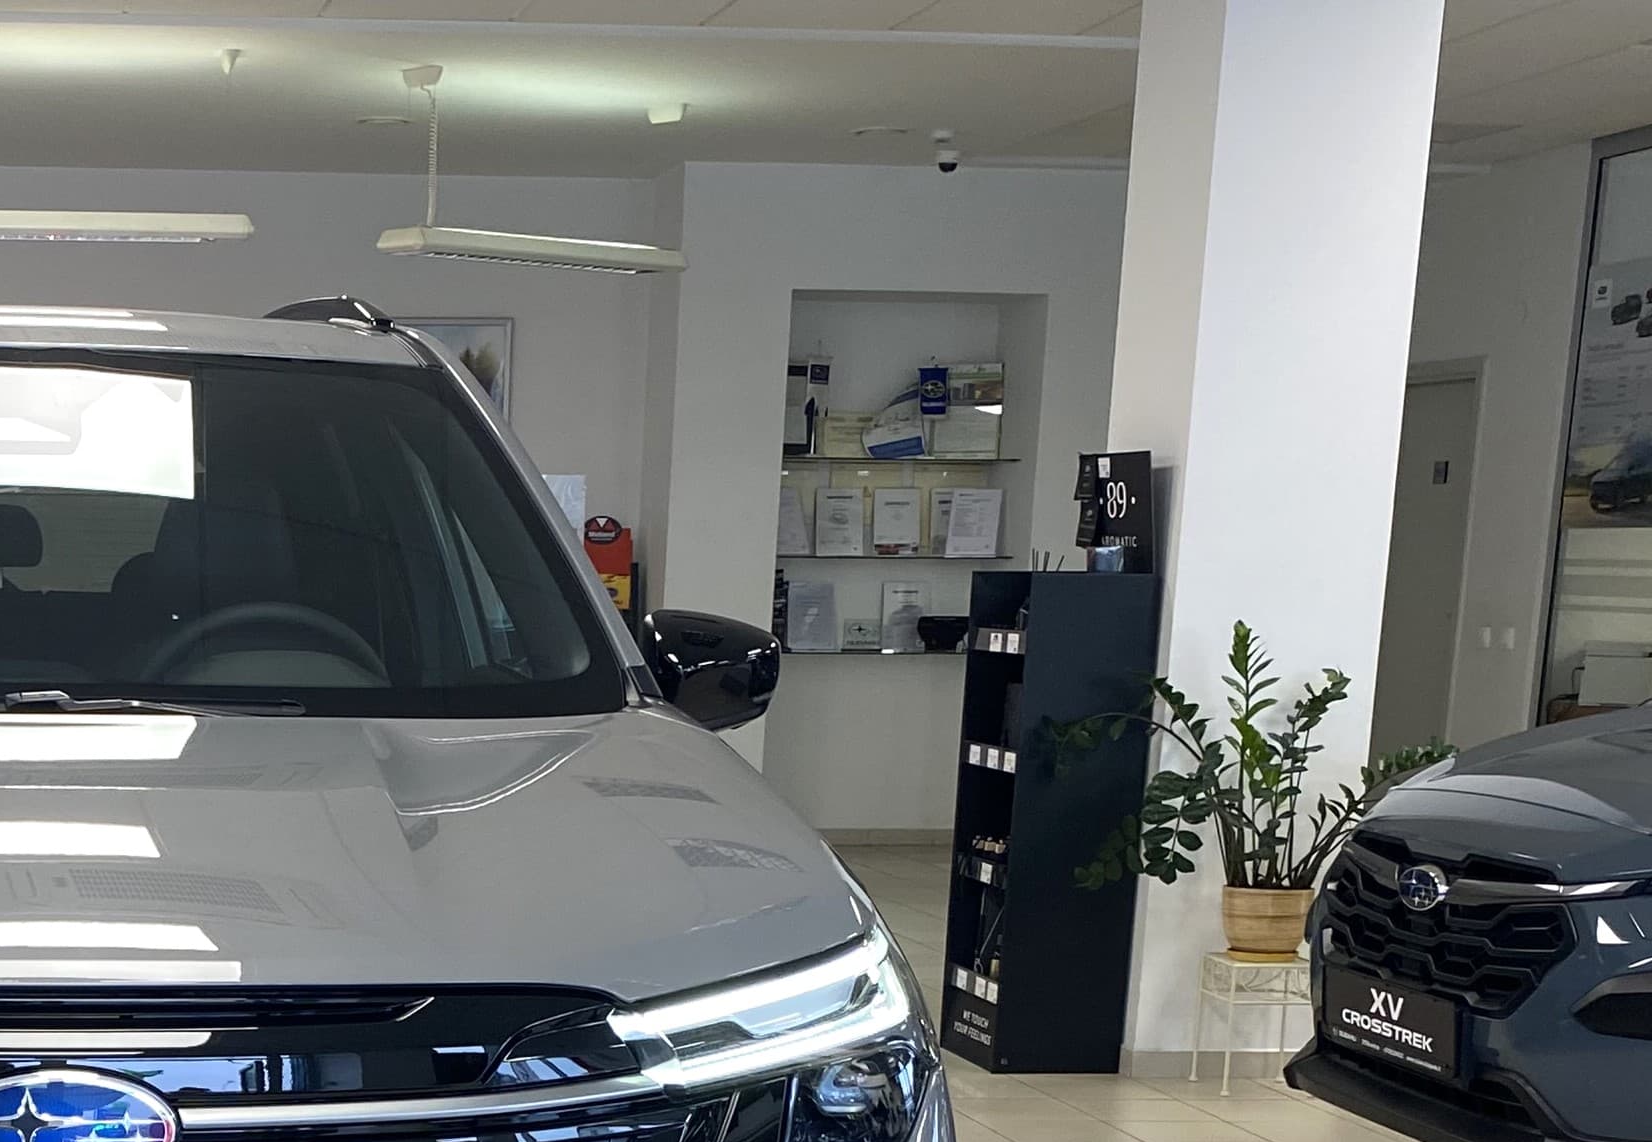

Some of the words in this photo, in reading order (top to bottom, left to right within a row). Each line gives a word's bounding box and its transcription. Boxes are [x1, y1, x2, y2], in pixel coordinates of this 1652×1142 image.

[1106, 481, 1127, 519] 89
[971, 1012, 989, 1029] TOUCH
[1369, 987, 1404, 1021] XV
[1342, 1008, 1433, 1053] CROSSTREK
